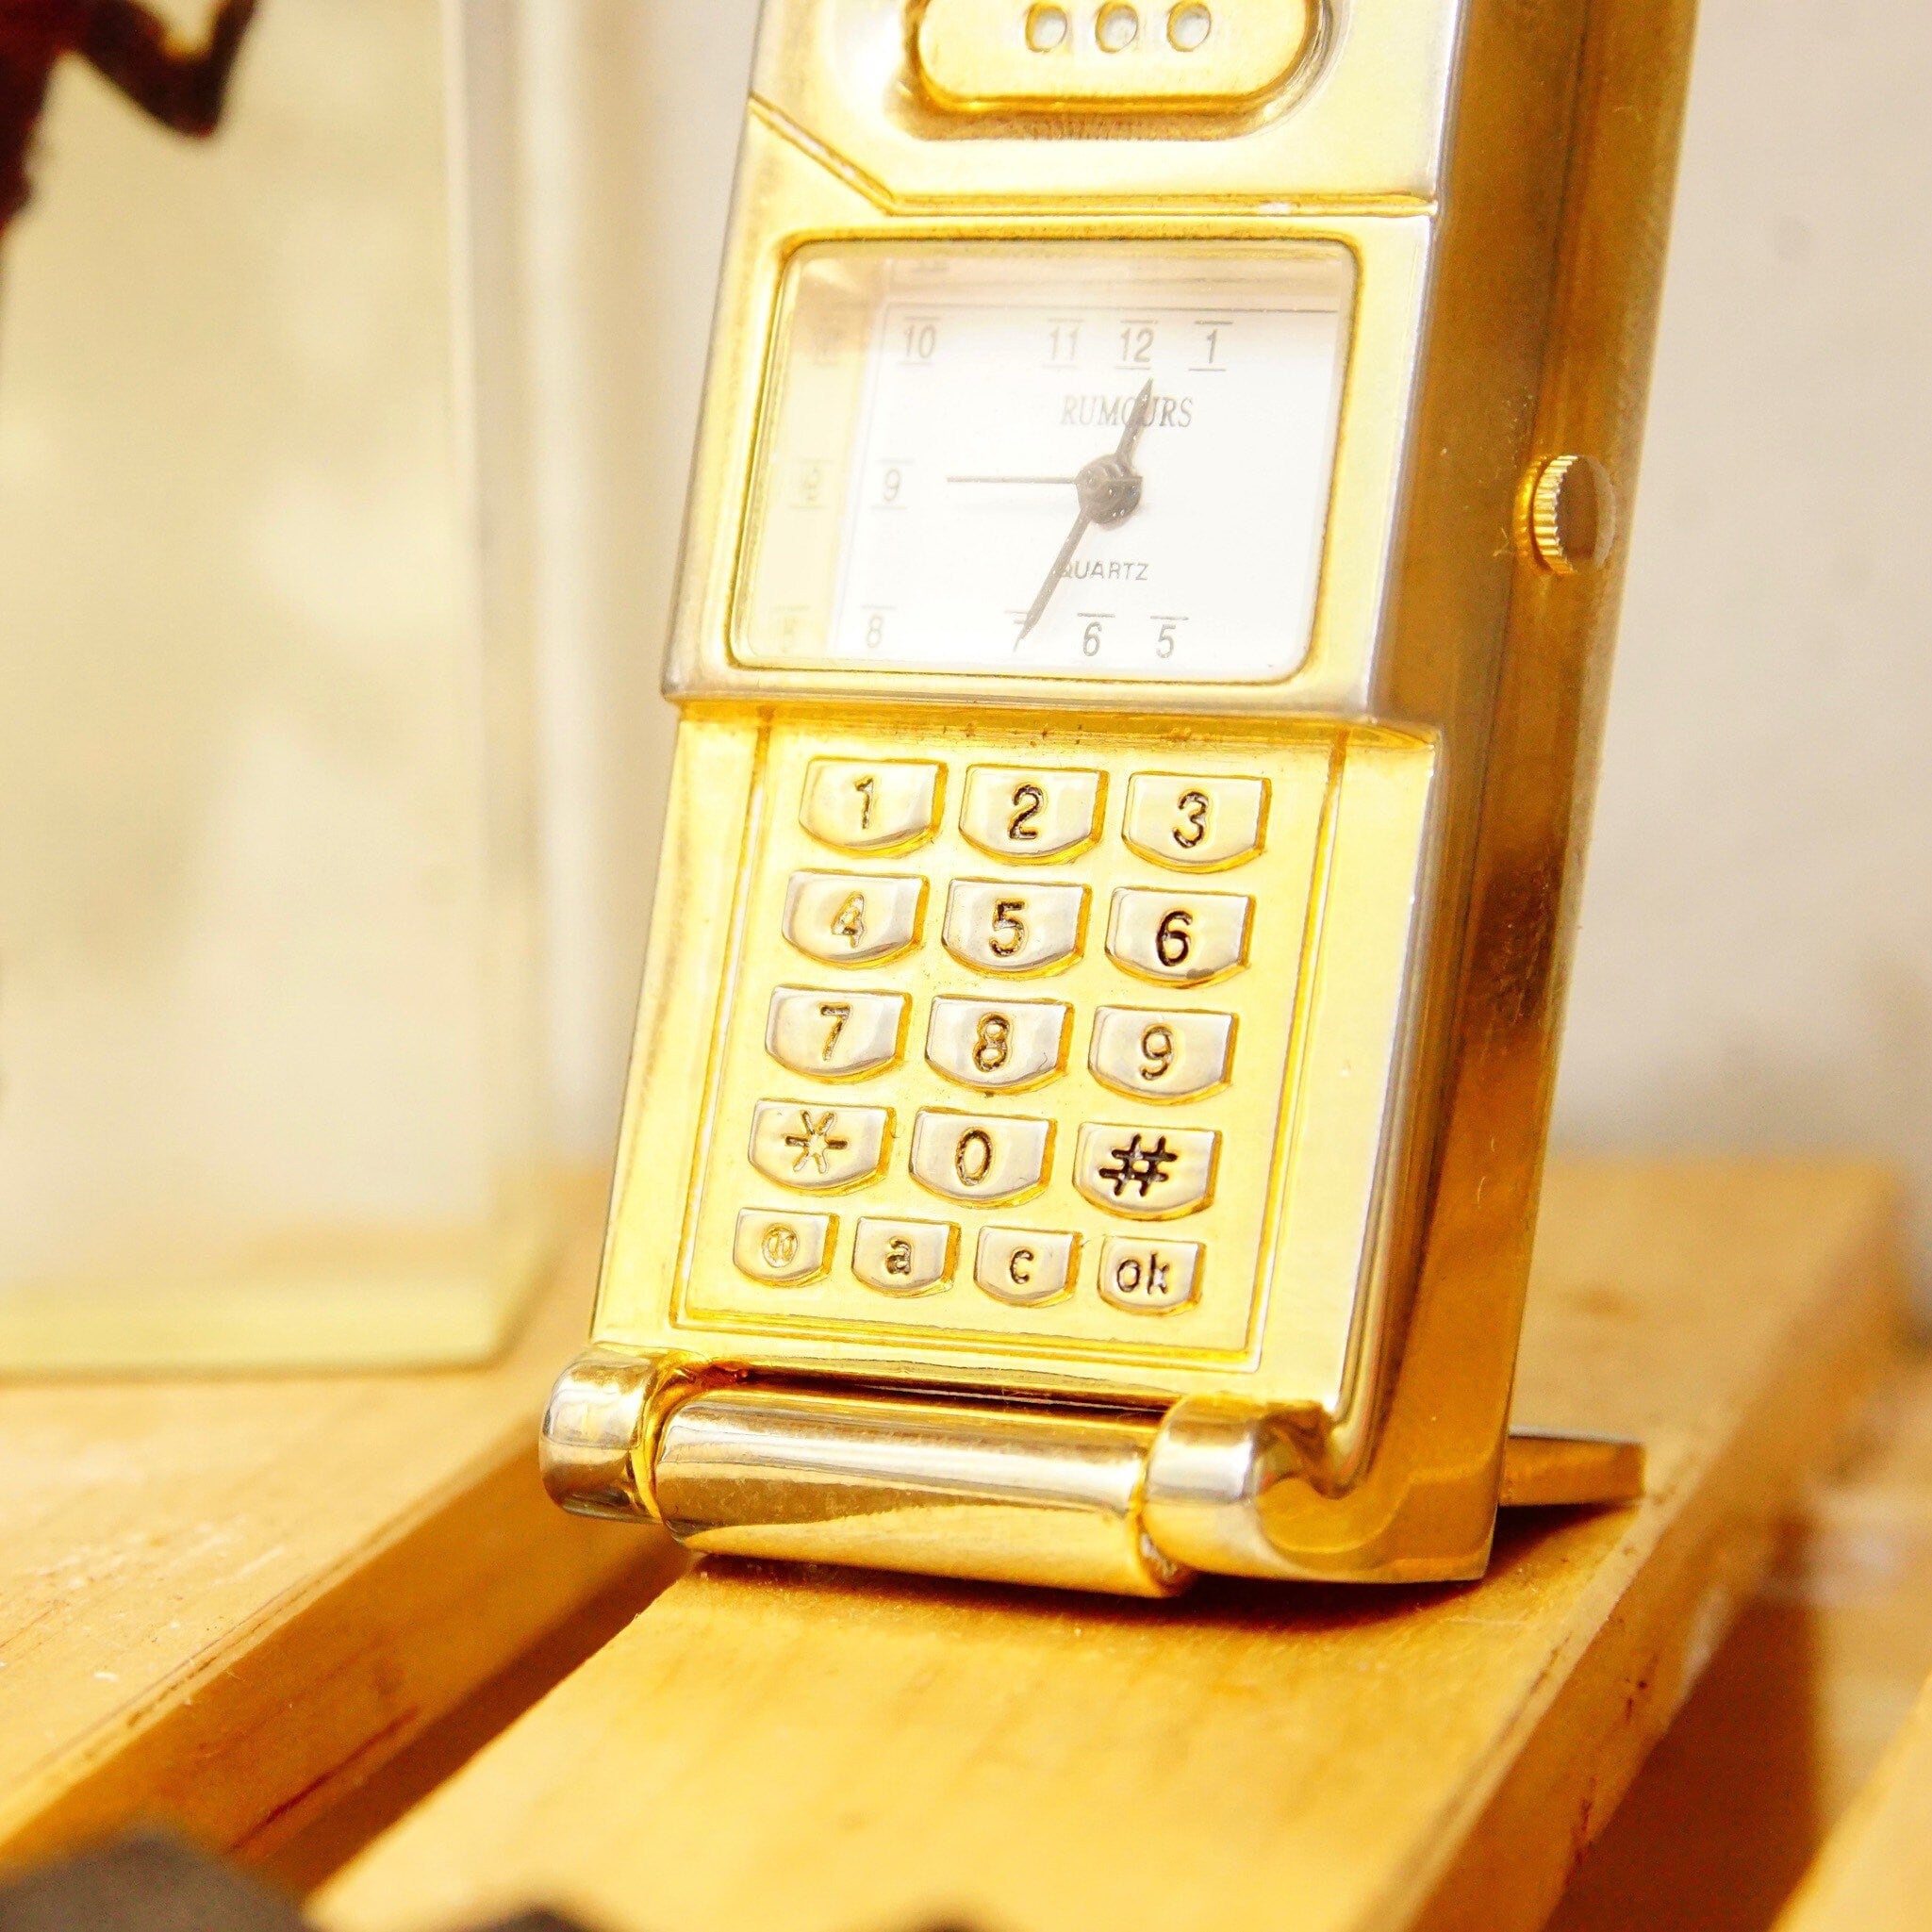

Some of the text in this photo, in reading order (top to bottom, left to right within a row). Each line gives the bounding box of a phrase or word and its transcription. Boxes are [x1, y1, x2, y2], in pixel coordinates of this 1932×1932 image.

[902, 323, 937, 360] 10
[1049, 326, 1081, 362] 11
[1120, 326, 1155, 363] 12
[1206, 328, 1219, 364] 1
[883, 468, 902, 503] 9
[1082, 620, 1103, 657] 6
[1155, 623, 1177, 659] 5
[854, 777, 875, 830] 1
[1008, 783, 1046, 841] 2
[1172, 790, 1212, 850] 3
[830, 890, 867, 949] 4
[990, 900, 1027, 958] 5
[1154, 909, 1195, 967] 6
[817, 1004, 852, 1061] 7
[971, 1013, 1011, 1073] 8
[1139, 1026, 1174, 1082] 9
[1097, 1131, 1180, 1198] #
[883, 1238, 914, 1276] a
[1115, 1251, 1171, 1296] ok
